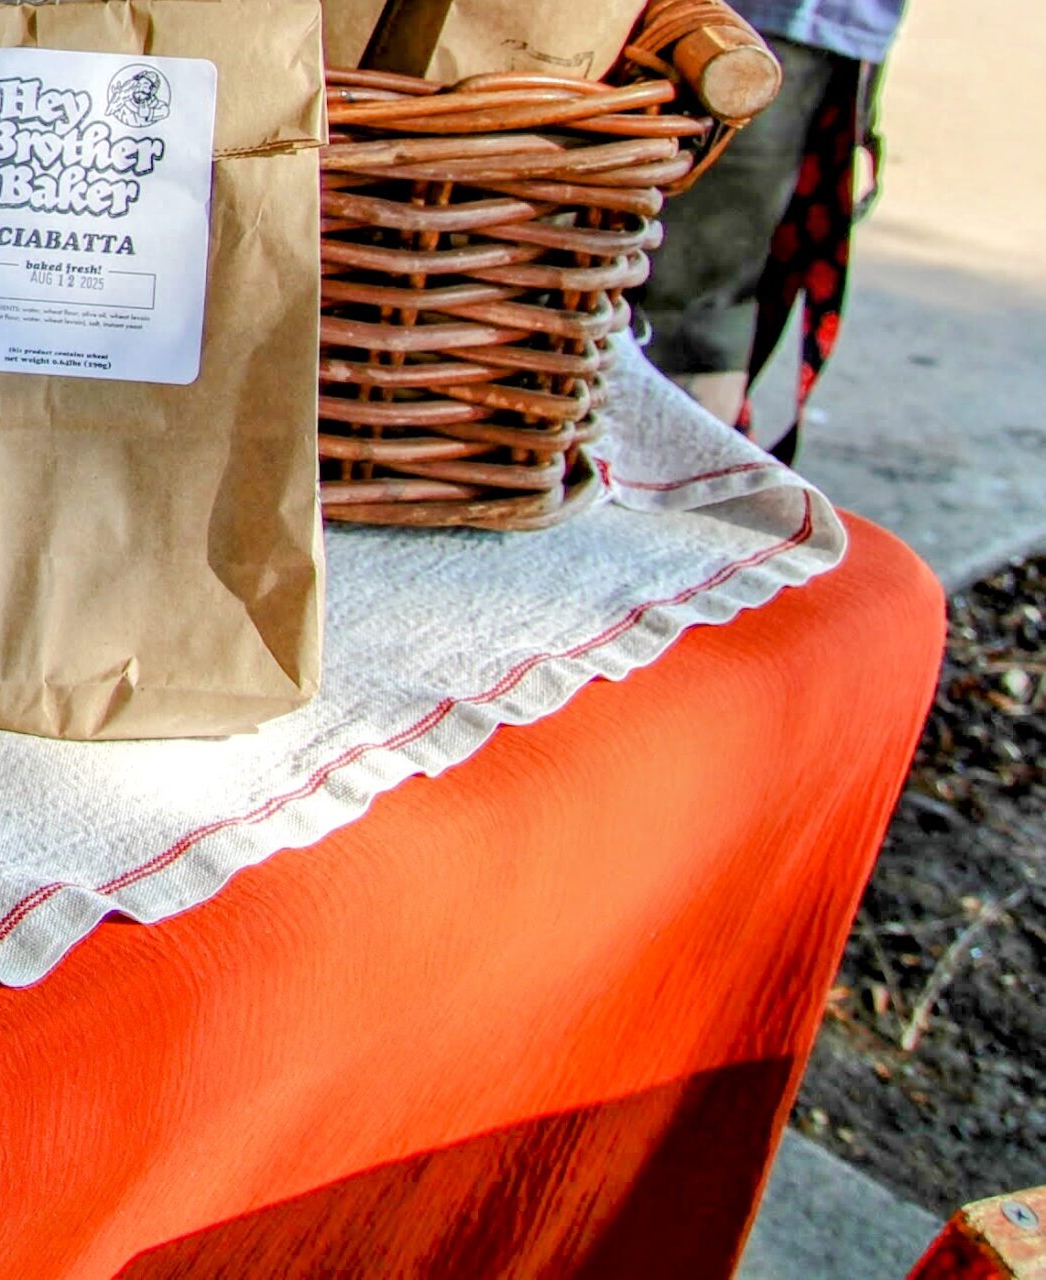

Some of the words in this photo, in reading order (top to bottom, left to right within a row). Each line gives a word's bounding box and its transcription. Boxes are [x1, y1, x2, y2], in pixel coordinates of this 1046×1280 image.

[26, 260, 62, 272] baked
[65, 264, 102, 275] fresh!
[30, 271, 52, 285] AUG
[80, 276, 104, 291] 2025
[21, 357, 50, 366] weight
